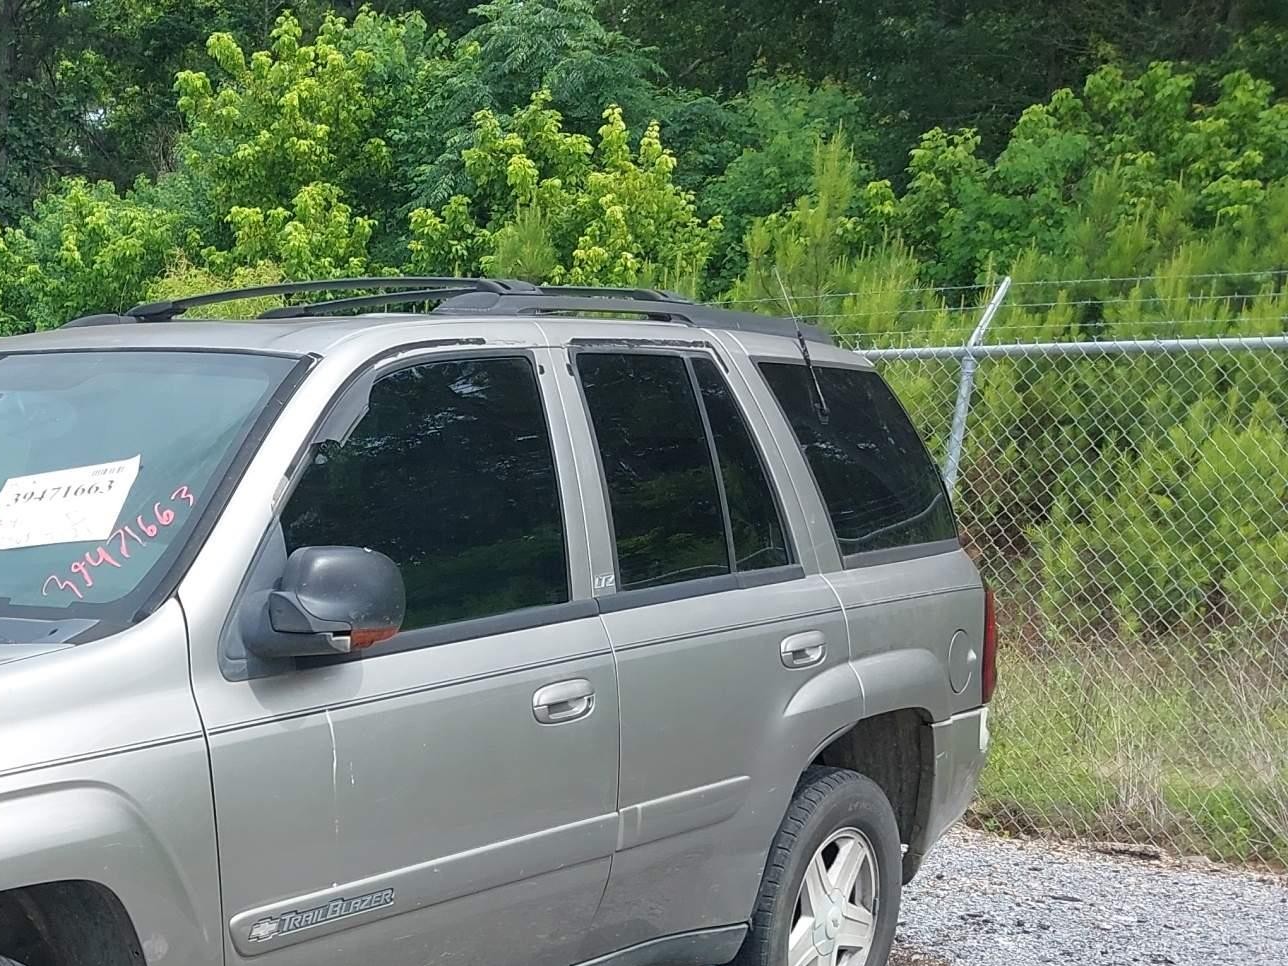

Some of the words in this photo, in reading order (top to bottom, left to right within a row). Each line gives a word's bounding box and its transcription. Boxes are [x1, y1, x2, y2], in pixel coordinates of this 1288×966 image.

[6, 479, 116, 508] 39471663
[41, 485, 195, 599] 39471663
[594, 573, 616, 589] LTZ
